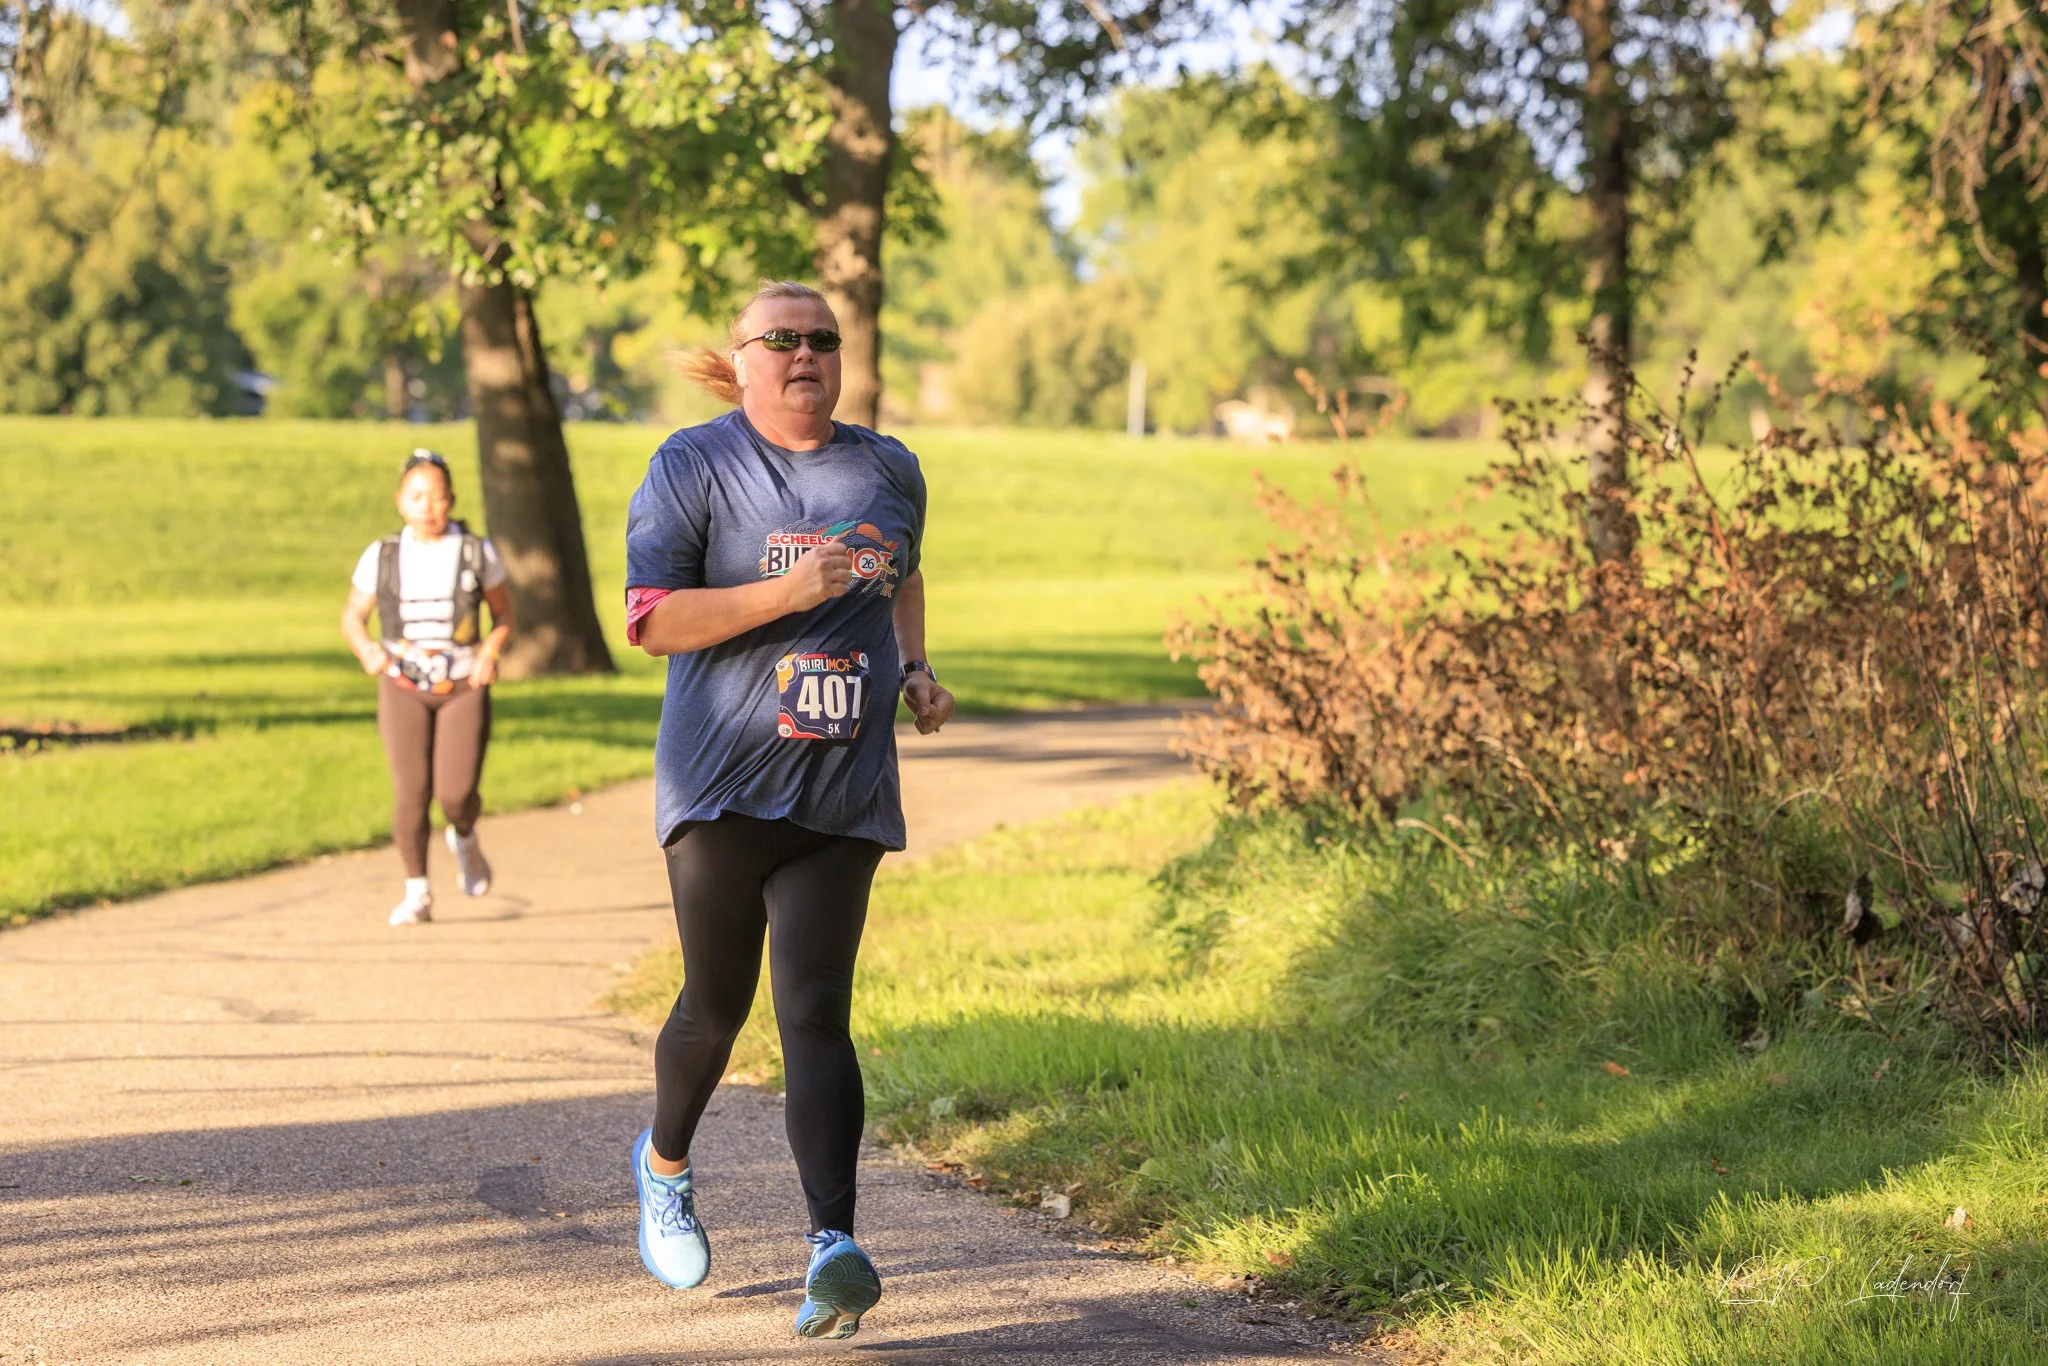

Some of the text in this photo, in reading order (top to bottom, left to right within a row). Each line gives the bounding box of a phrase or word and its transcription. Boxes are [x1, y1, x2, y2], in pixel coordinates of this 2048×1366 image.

[768, 534, 834, 545] SCHEELS
[862, 557, 875, 570] 26
[799, 658, 852, 672] BURLIMOT
[797, 674, 862, 720] 407
[828, 723, 840, 734] 5K
